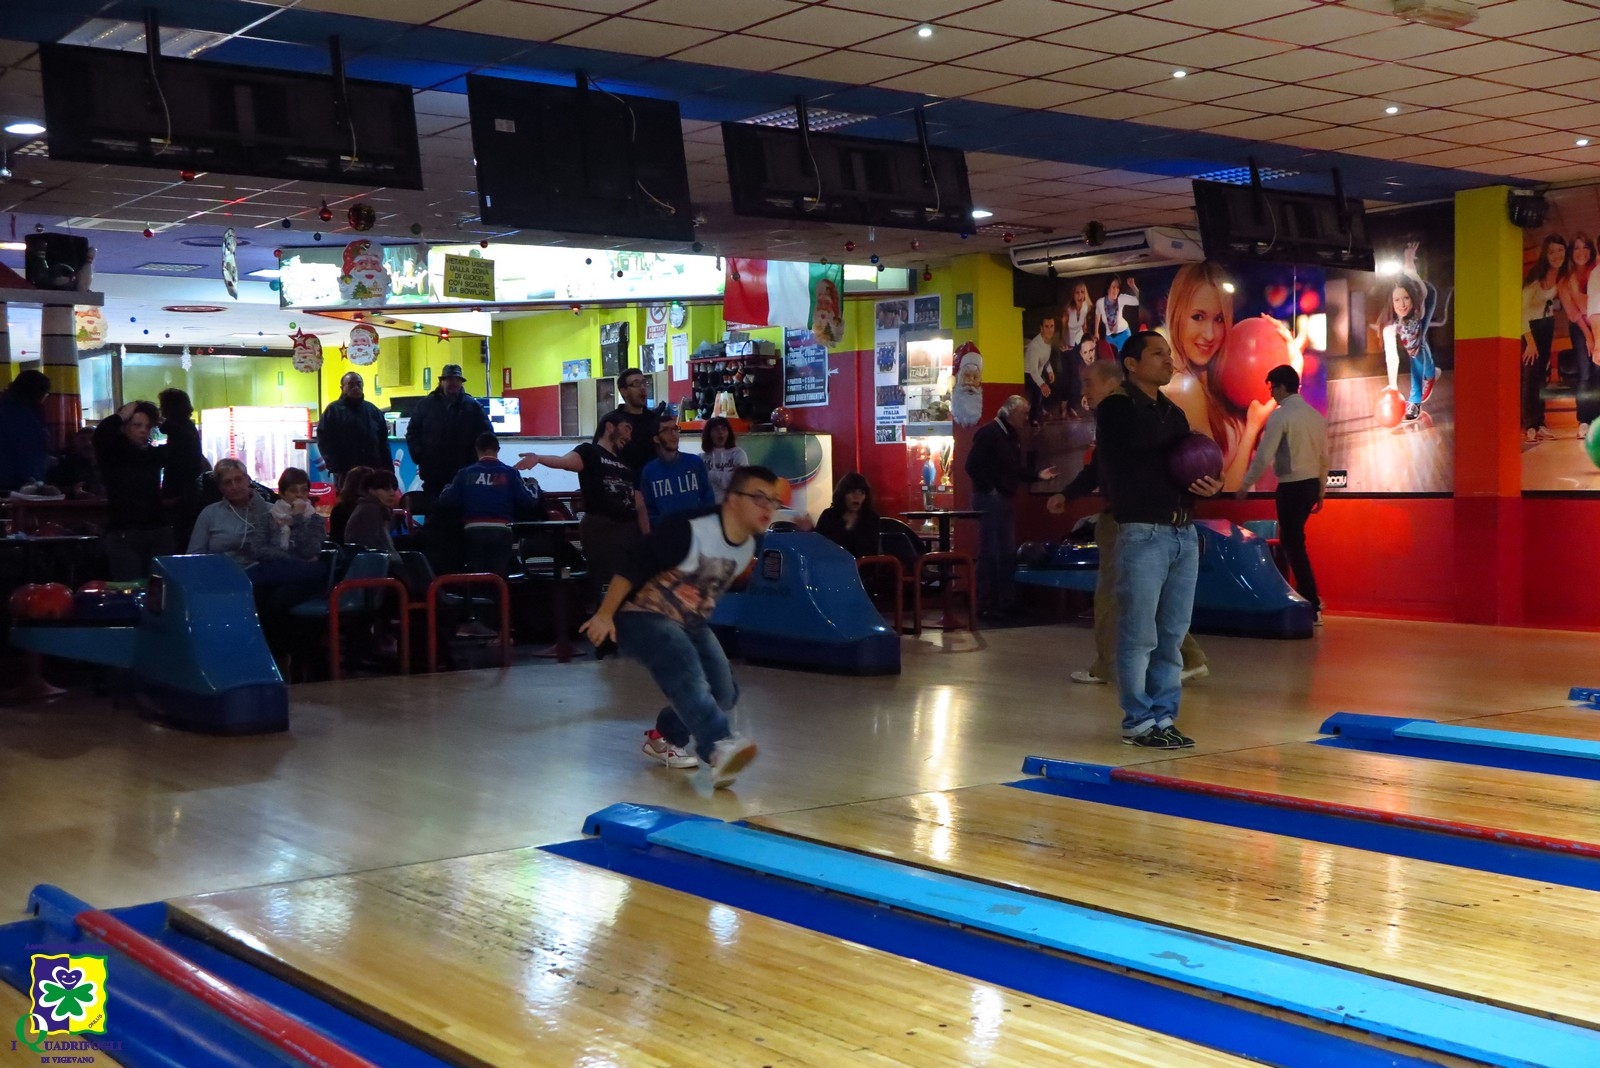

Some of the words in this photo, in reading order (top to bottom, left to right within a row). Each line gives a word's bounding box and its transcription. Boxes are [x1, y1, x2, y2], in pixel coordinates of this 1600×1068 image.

[446, 257, 470, 266] VIETATO
[450, 265, 470, 273] DALLA
[472, 267, 490, 276] ZONA
[463, 274, 484, 282] GIOCO
[448, 279, 463, 287] CON
[465, 281, 490, 290] SCARPE
[460, 288, 490, 297] BOWLING
